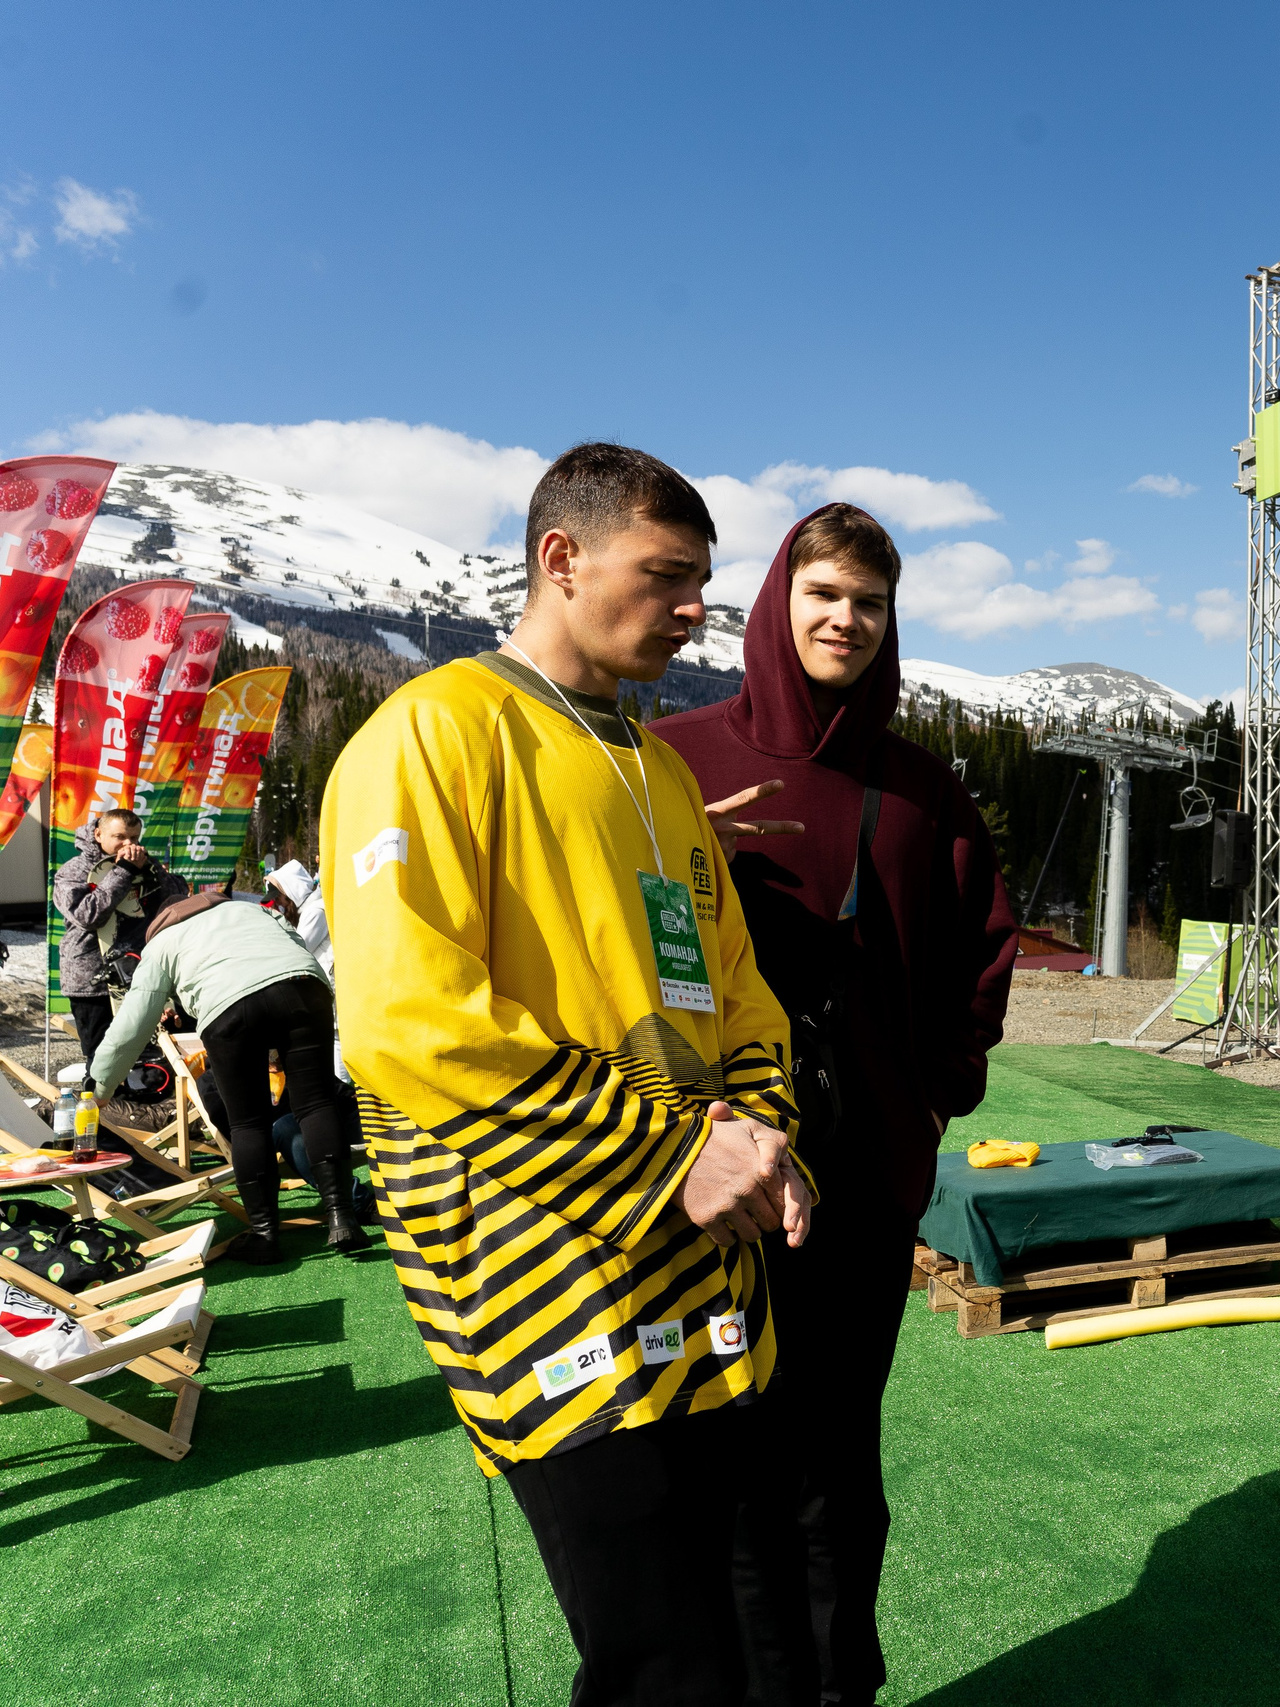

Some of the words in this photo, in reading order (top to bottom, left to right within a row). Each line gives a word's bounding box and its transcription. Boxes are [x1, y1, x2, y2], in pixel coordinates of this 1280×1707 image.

[88, 677, 134, 824] илад
[659, 941, 699, 964] КОМАНДА
[1140, 1284, 1160, 1302] 21
[970, 1310, 994, 1329] 21
